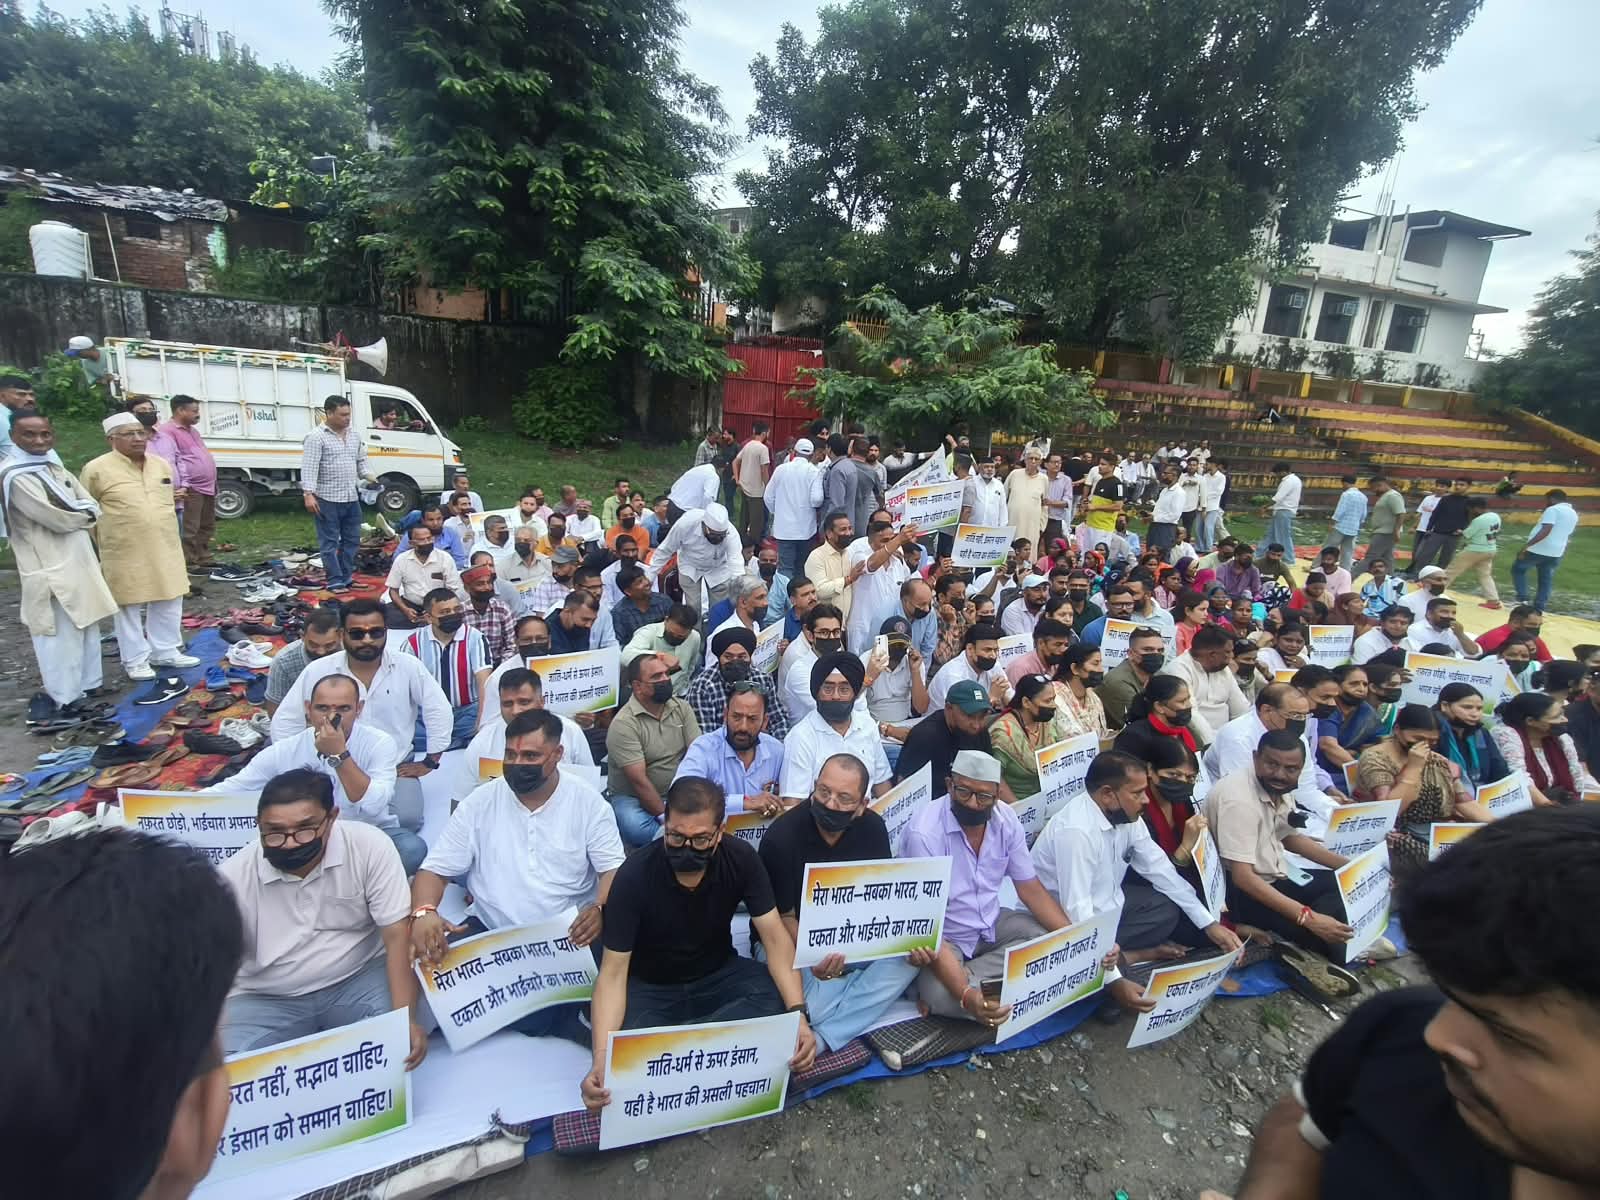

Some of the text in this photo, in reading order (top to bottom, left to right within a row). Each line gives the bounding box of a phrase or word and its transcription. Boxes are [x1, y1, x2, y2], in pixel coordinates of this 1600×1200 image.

[191, 812, 226, 831] भाईचारा
[813, 882, 829, 906] मेरा
[894, 881, 919, 901] भारत,
[923, 880, 943, 898] प्यार
[809, 927, 837, 947] एकता
[838, 919, 856, 943] और
[858, 916, 890, 942] भाईचारे
[892, 919, 905, 937] का
[433, 970, 456, 992] मेरा
[525, 941, 556, 958] भारत,
[1025, 956, 1048, 978] एकता
[1049, 941, 1070, 970] हमारी
[1070, 936, 1091, 958] ताकत
[450, 998, 487, 1027] एकता
[486, 985, 509, 1010] और
[505, 972, 547, 998] भाईचारे
[545, 973, 561, 988] का
[1012, 990, 1047, 1021] इंसानियत
[1047, 975, 1067, 1002] हमारी
[1067, 967, 1089, 989] पहचान
[1166, 981, 1190, 998] एकता
[1146, 1009, 1182, 1032] इंसानियत
[258, 1065, 290, 1096] नहीं,
[294, 1057, 338, 1090] सद्भाव
[342, 1041, 388, 1075] चाहिए,
[647, 1045, 759, 1077] जाति-धर्म से ऊपर इंसान,
[624, 1094, 644, 1117] यही
[647, 1091, 655, 1115] है
[657, 1093, 683, 1112] भारत
[685, 1085, 700, 1107] की
[701, 1080, 733, 1104] असली
[229, 1125, 270, 1155] इंसान
[273, 1113, 294, 1141] को
[298, 1105, 342, 1136] सम्मान
